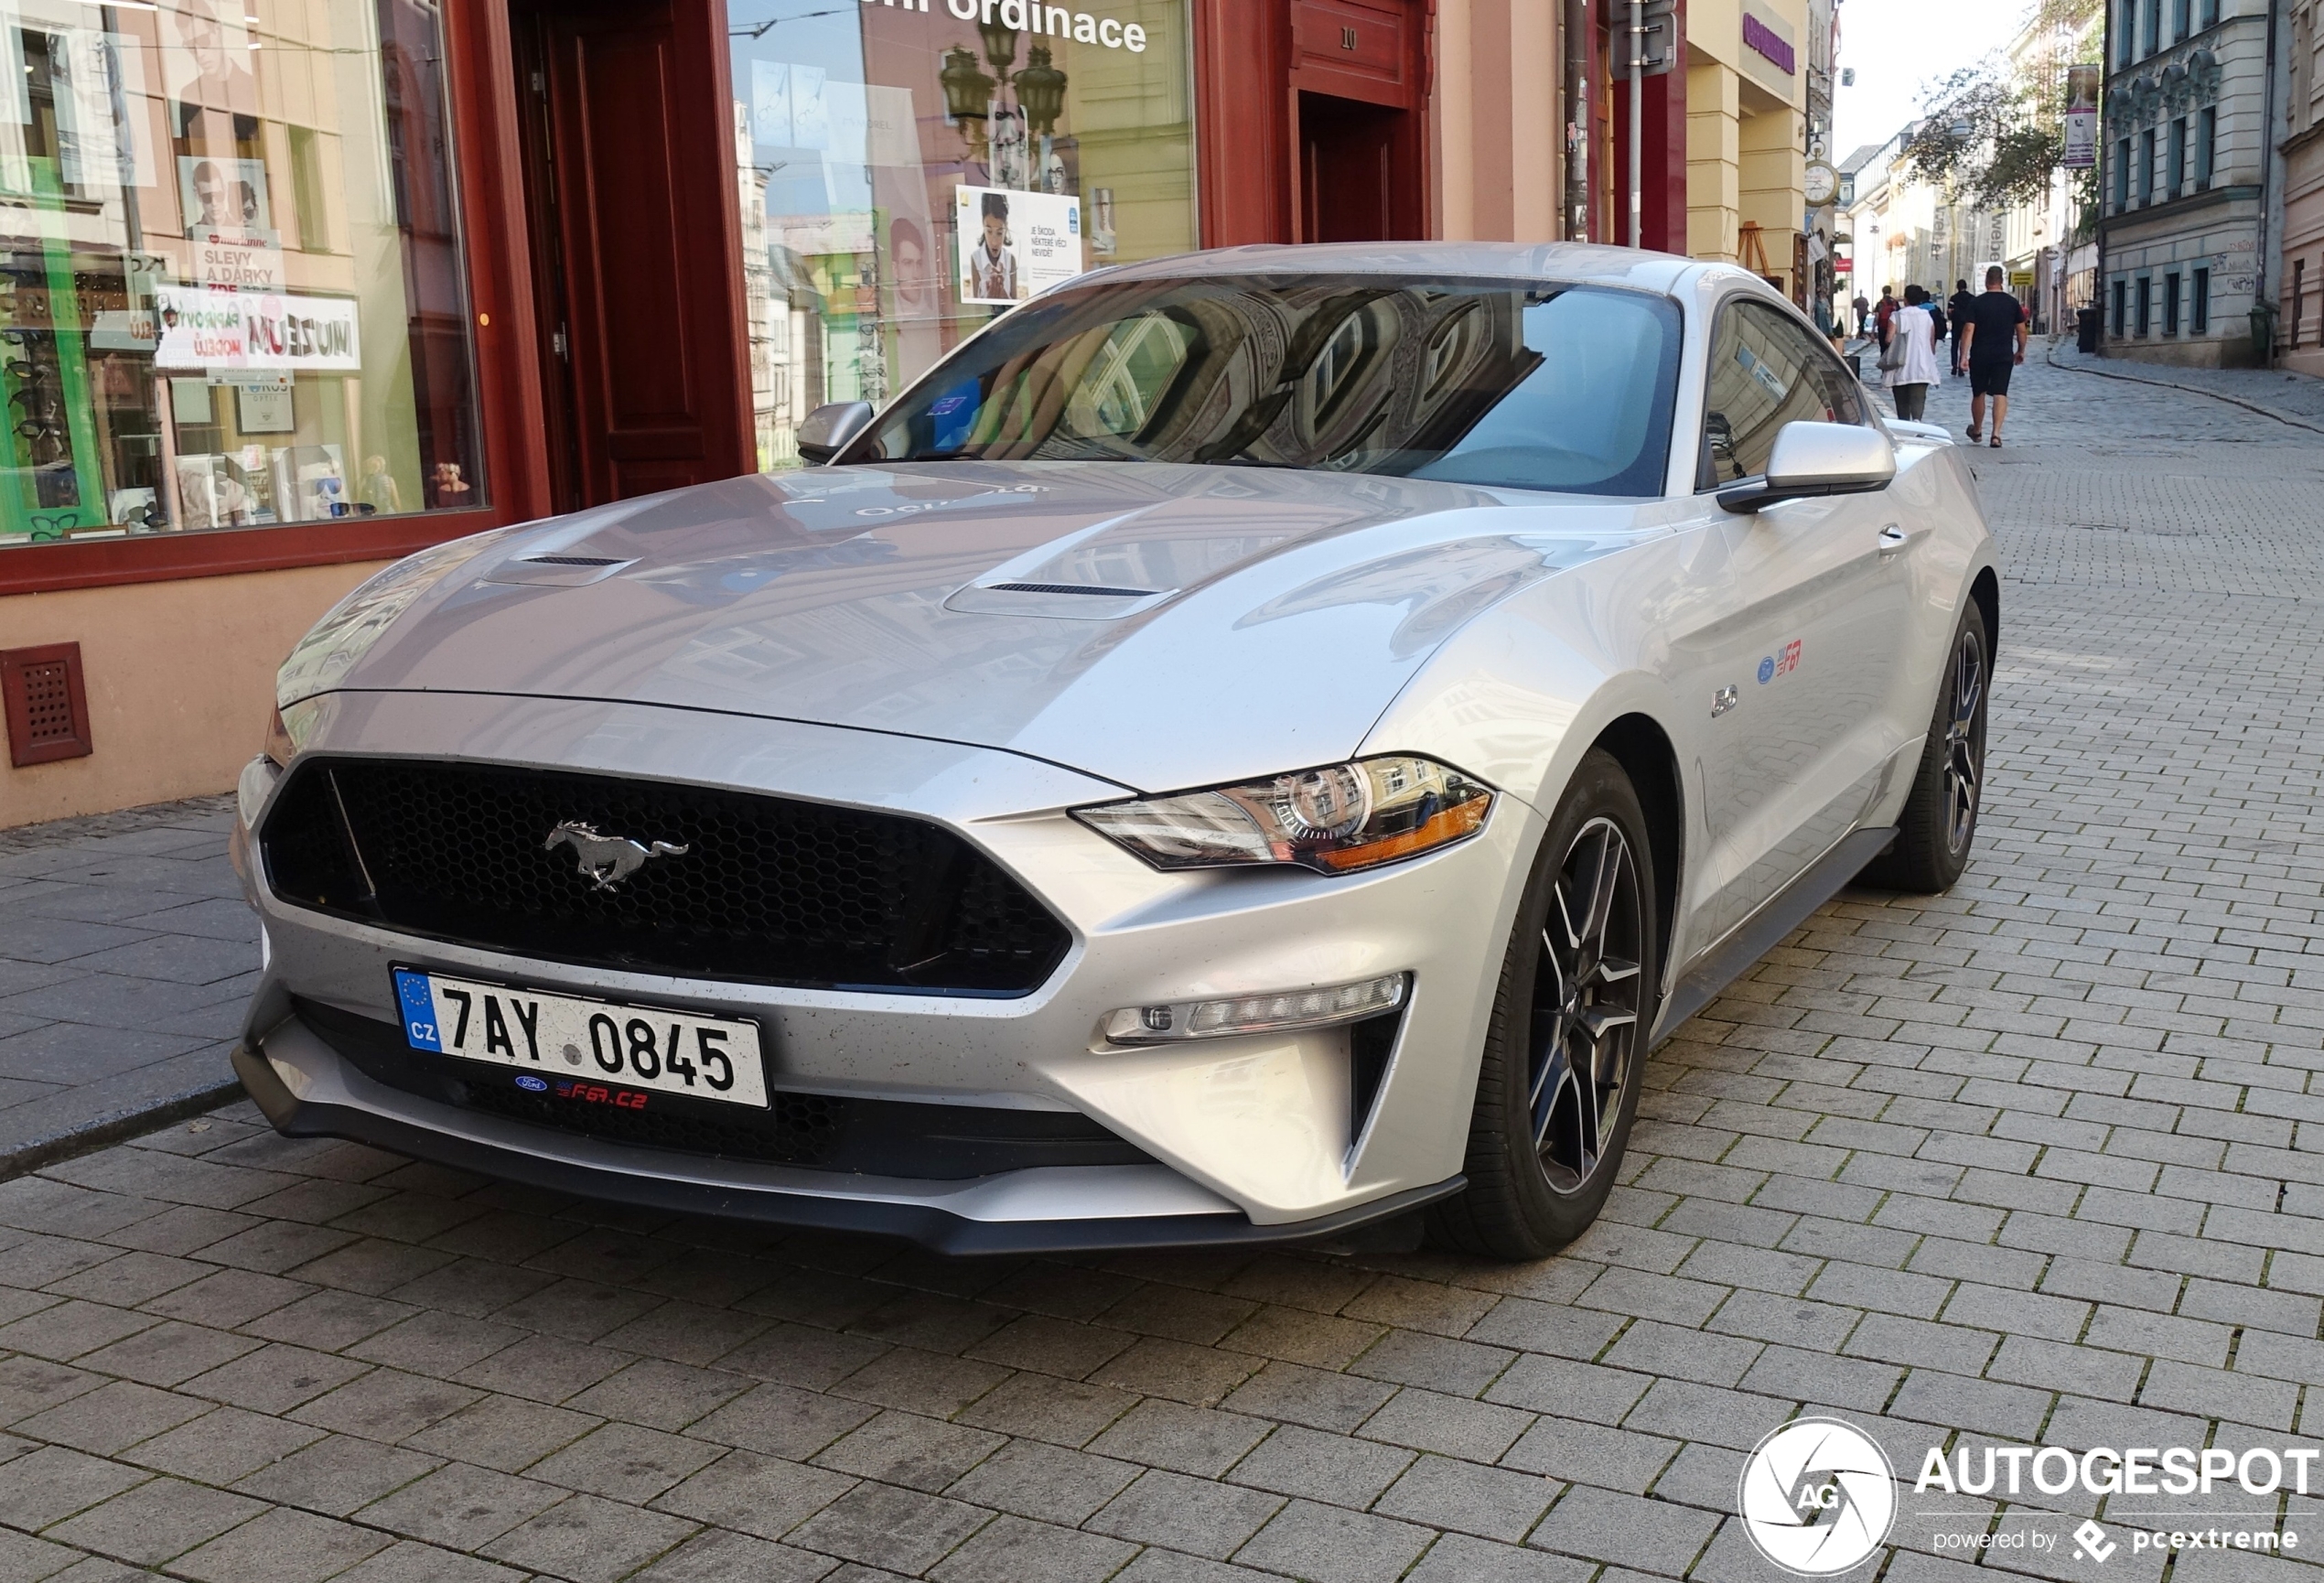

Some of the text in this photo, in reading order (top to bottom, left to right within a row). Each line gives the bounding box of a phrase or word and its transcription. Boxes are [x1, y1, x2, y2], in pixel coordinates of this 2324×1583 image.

[947, 0, 1146, 53] ordinace
[1341, 27, 1357, 50] 10
[1038, 225, 1056, 236] ŠKODA
[1989, 211, 2006, 263] webe
[1031, 236, 1054, 248] NĚKTERÉ
[204, 250, 252, 264] SLEVY
[1031, 247, 1053, 258] NEVIDĚT
[207, 265, 274, 284] A DÁRKY
[411, 987, 734, 1092] CZ 7AY 0845
[519, 1076, 543, 1090] Ford
